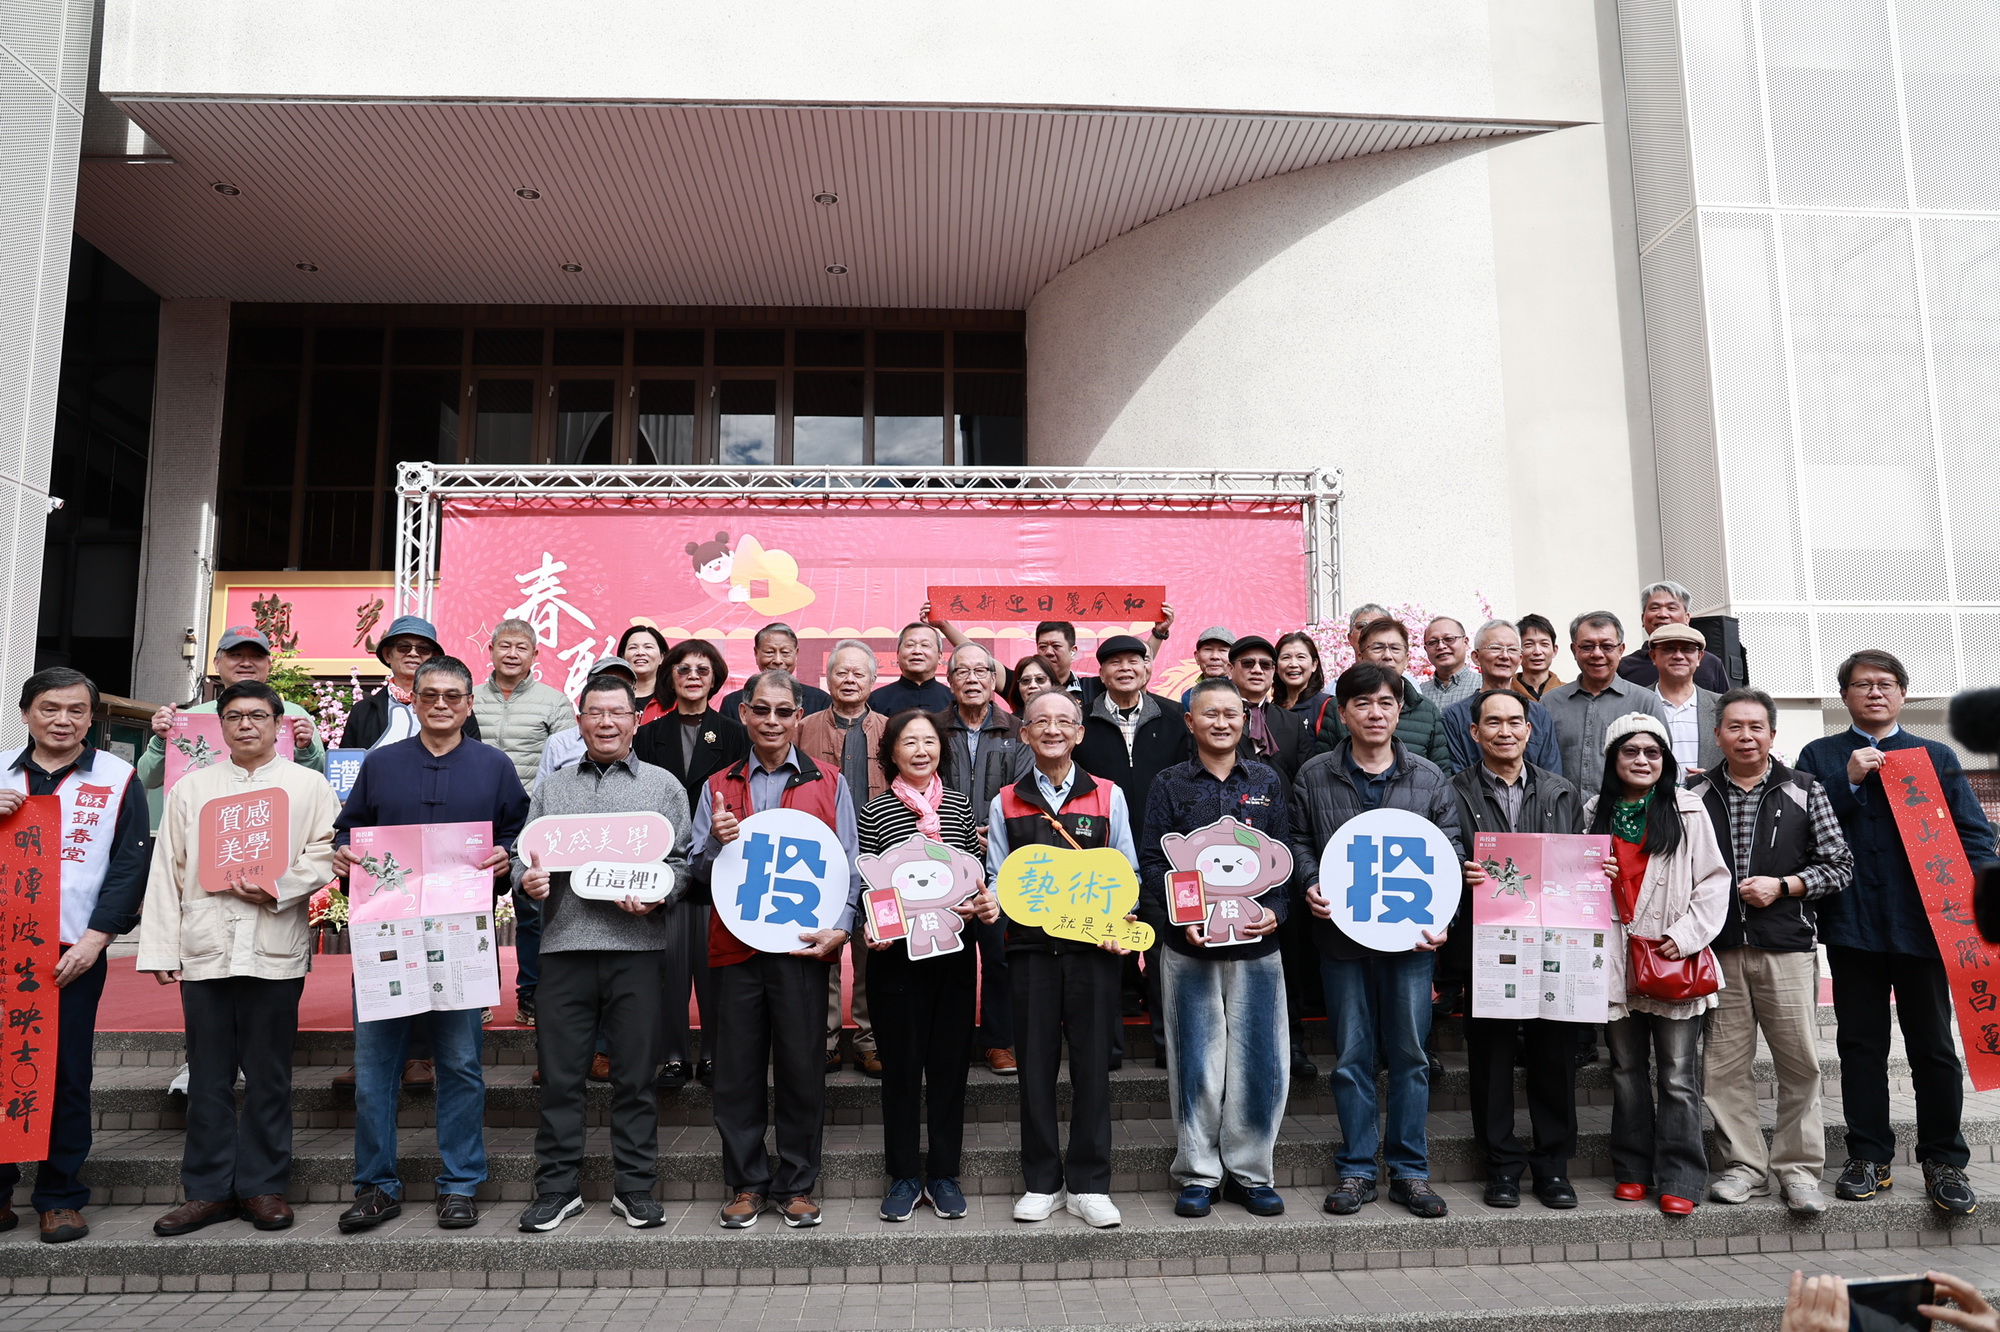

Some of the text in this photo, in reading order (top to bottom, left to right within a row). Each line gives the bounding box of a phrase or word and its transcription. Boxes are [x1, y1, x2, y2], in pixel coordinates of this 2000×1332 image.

[330, 759, 361, 792] 讚
[218, 800, 270, 834] 質感
[60, 810, 100, 863] 錦春堂
[217, 831, 271, 867] 美學
[544, 824, 649, 857] 質感美學
[584, 867, 657, 891] 在這裡!
[735, 832, 827, 928] 投
[1018, 852, 1122, 915] 藝術
[1346, 834, 1434, 925] 投
[403, 893, 417, 911] 2
[1219, 900, 1239, 919] 投
[1524, 900, 1538, 919] 2
[919, 912, 940, 932] 投
[1052, 913, 1149, 945] 就是生活!
